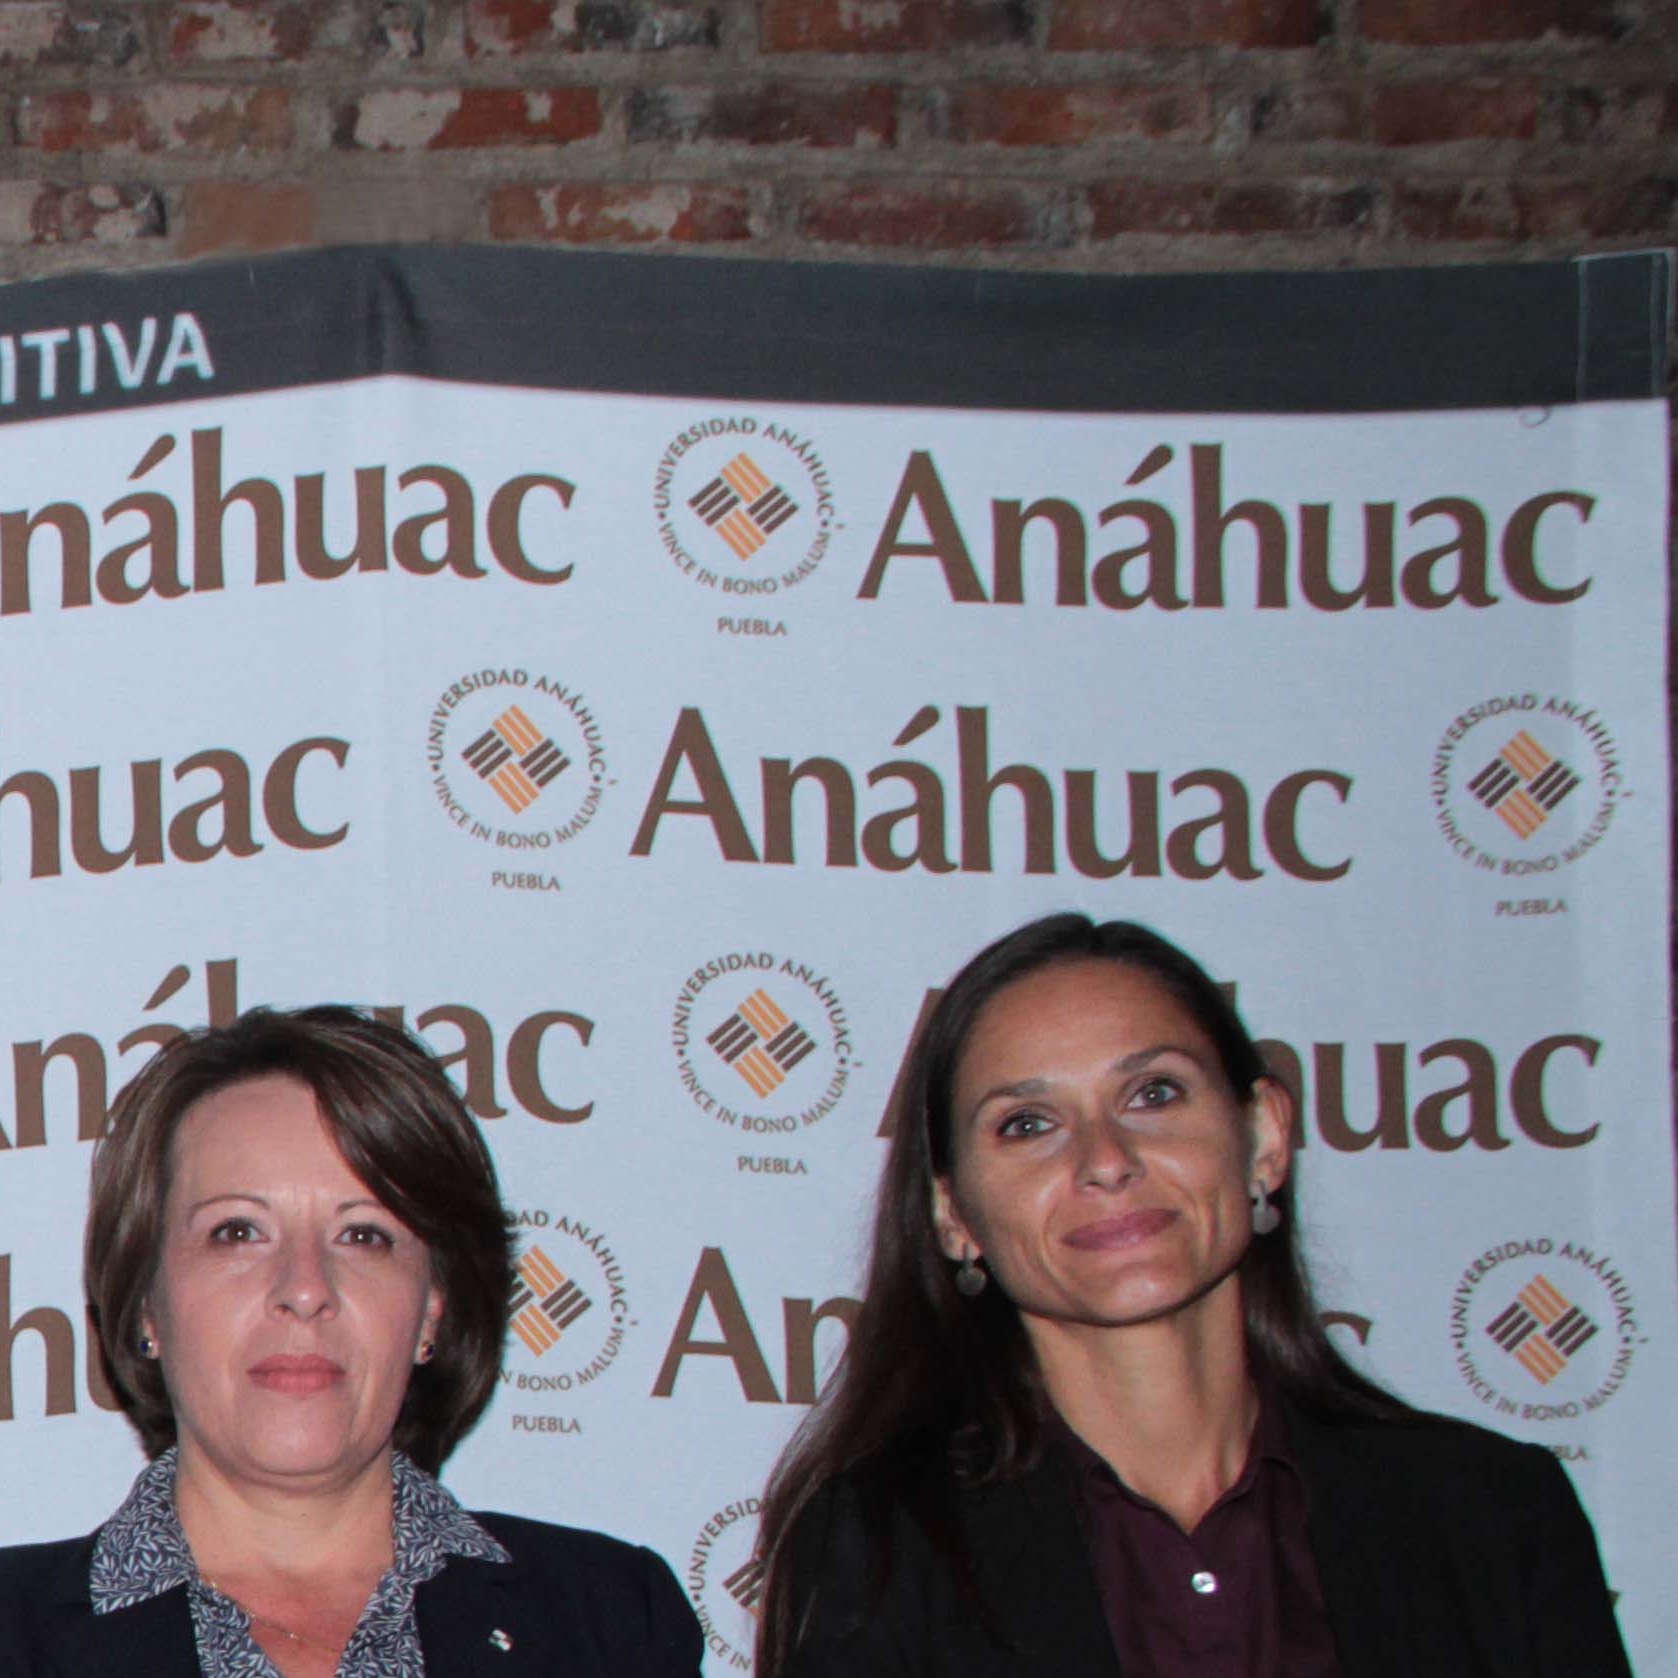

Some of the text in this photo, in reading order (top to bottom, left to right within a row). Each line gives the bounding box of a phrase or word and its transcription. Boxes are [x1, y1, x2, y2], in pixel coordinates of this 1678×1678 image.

[653, 416, 836, 518] UNIVERSIDAD ANÁHUAC
[658, 520, 832, 596] VINCE IN BONO MALUM
[858, 444, 1596, 611] Anáhuac
[717, 616, 788, 637] PUEBLA
[426, 668, 607, 773] UNIVERSIDAD ANÁHUAC
[431, 772, 604, 850] VINCE IN BONO MALUM
[630, 706, 1353, 882] Anáhuac
[491, 870, 562, 892] PUEBLA
[671, 951, 854, 1055] UNIVERSIDAD ANÁHUAC
[677, 1058, 850, 1134] VINCE IN BONO MALUM
[737, 1155, 808, 1176] PUEBLA
[556, 1216, 629, 1314] ANÁHUAC
[517, 1327, 624, 1392] BONO MALUM
[512, 1414, 582, 1434] PUEBLA
